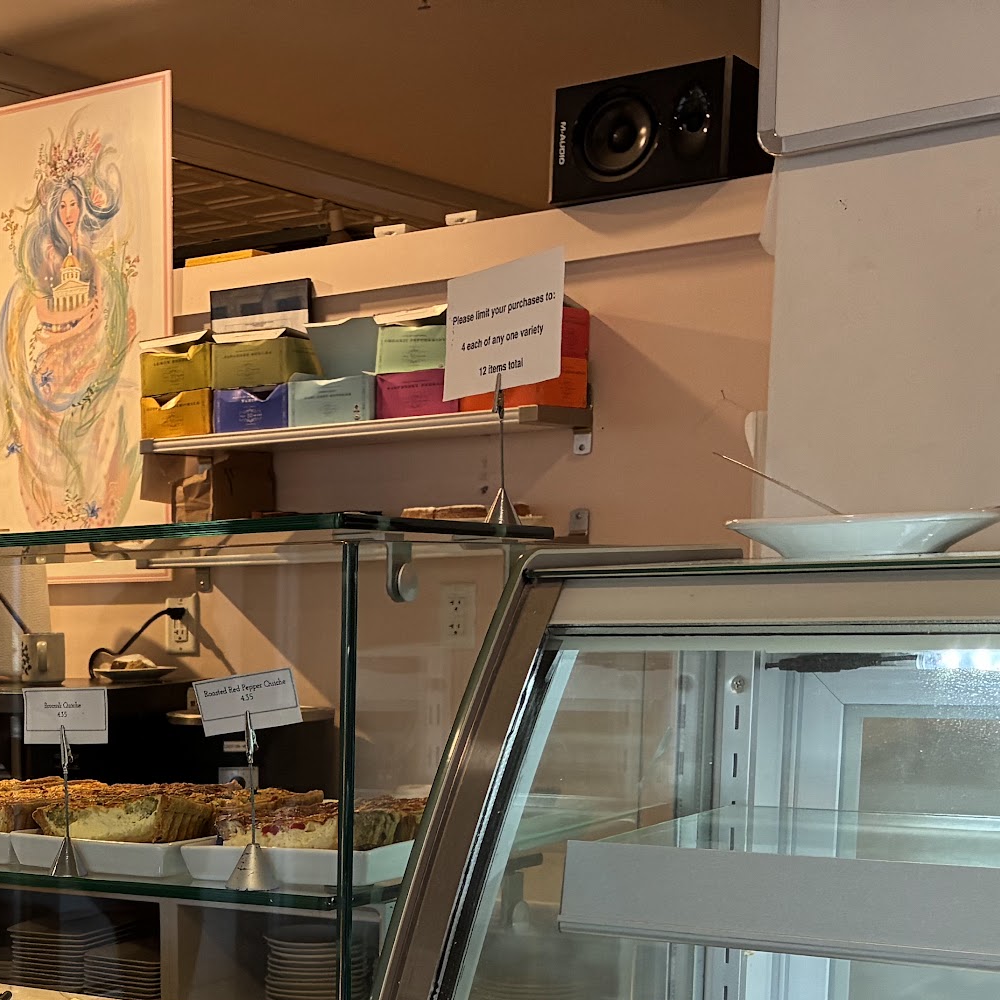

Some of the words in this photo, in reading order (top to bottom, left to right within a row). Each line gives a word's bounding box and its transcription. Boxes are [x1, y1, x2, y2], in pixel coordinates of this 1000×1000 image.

[452, 313, 474, 326] Please
[475, 308, 490, 320] limit
[491, 305, 507, 318] your
[507, 294, 544, 314] purchases
[546, 292, 556, 300] to:
[461, 342, 466, 352] 4
[467, 339, 482, 351] each
[483, 336, 491, 346] of
[492, 334, 505, 345] any
[506, 331, 518, 341] one
[520, 324, 544, 339] variety
[479, 367, 487, 376] 12
[488, 364, 507, 374] items
[508, 358, 524, 369] total
[203, 687, 228, 698] Roasted
[228, 685, 241, 693] Red
[241, 683, 262, 692] Pepper
[263, 678, 286, 688] Quiche
